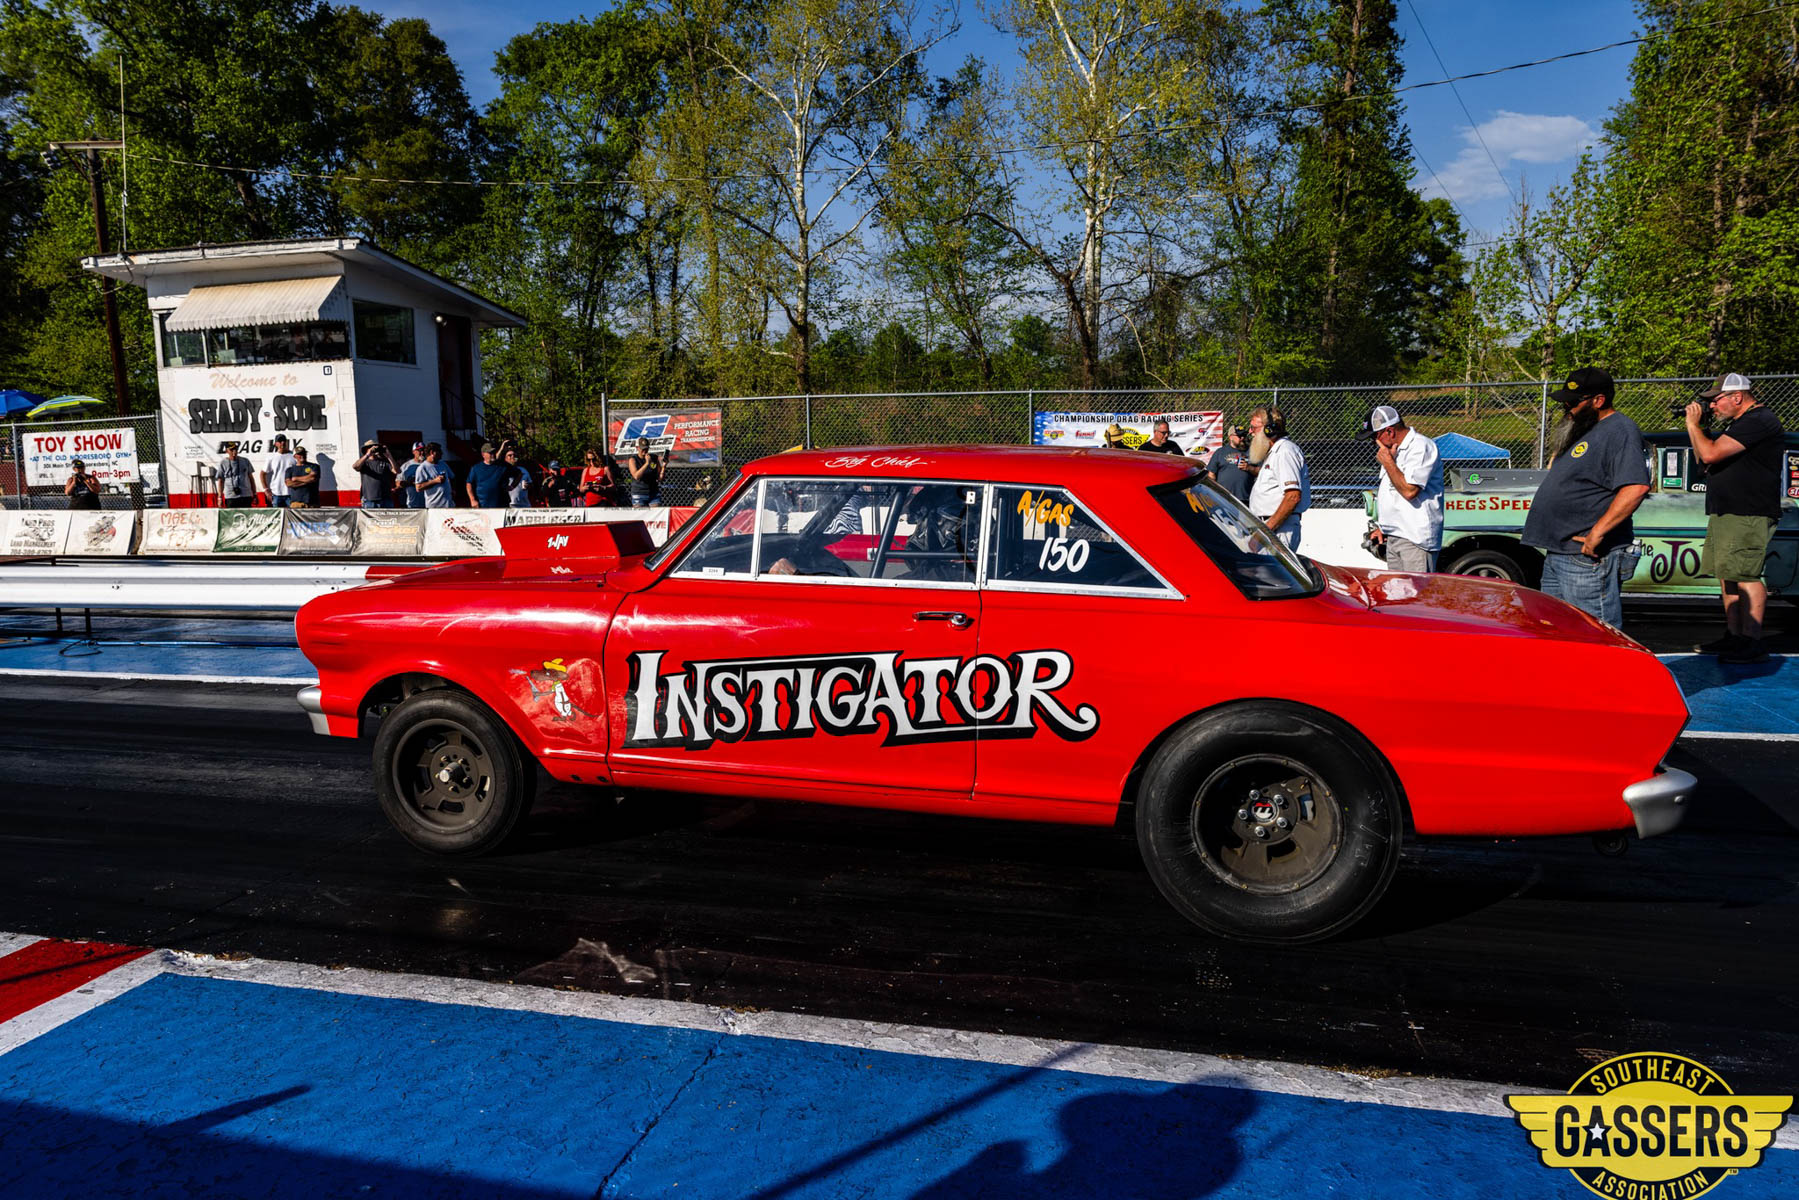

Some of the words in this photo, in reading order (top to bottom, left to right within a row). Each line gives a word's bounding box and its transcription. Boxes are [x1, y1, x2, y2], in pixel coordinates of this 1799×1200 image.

[209, 373, 277, 389] Welcome
[282, 373, 299, 386] to
[188, 398, 263, 434] SHADY
[273, 394, 328, 431] SIDE
[1054, 414, 1114, 423] CHAMPIONSHIP
[1116, 414, 1138, 423] DRAG
[1141, 414, 1171, 423] RACING
[1173, 414, 1204, 422] SERIES
[674, 419, 720, 430] PERFORMANCE
[684, 429, 710, 437] RACING
[34, 436, 66, 453] TOY
[73, 433, 122, 452] SHOW
[825, 455, 871, 468] Big
[871, 456, 928, 468] Chief
[91, 469, 131, 479] 9am-3pm
[1017, 490, 1074, 527] A/GAS
[1489, 496, 1532, 511] SPEE
[1039, 537, 1090, 573] 150
[623, 650, 1099, 748] INSTIGATOR
